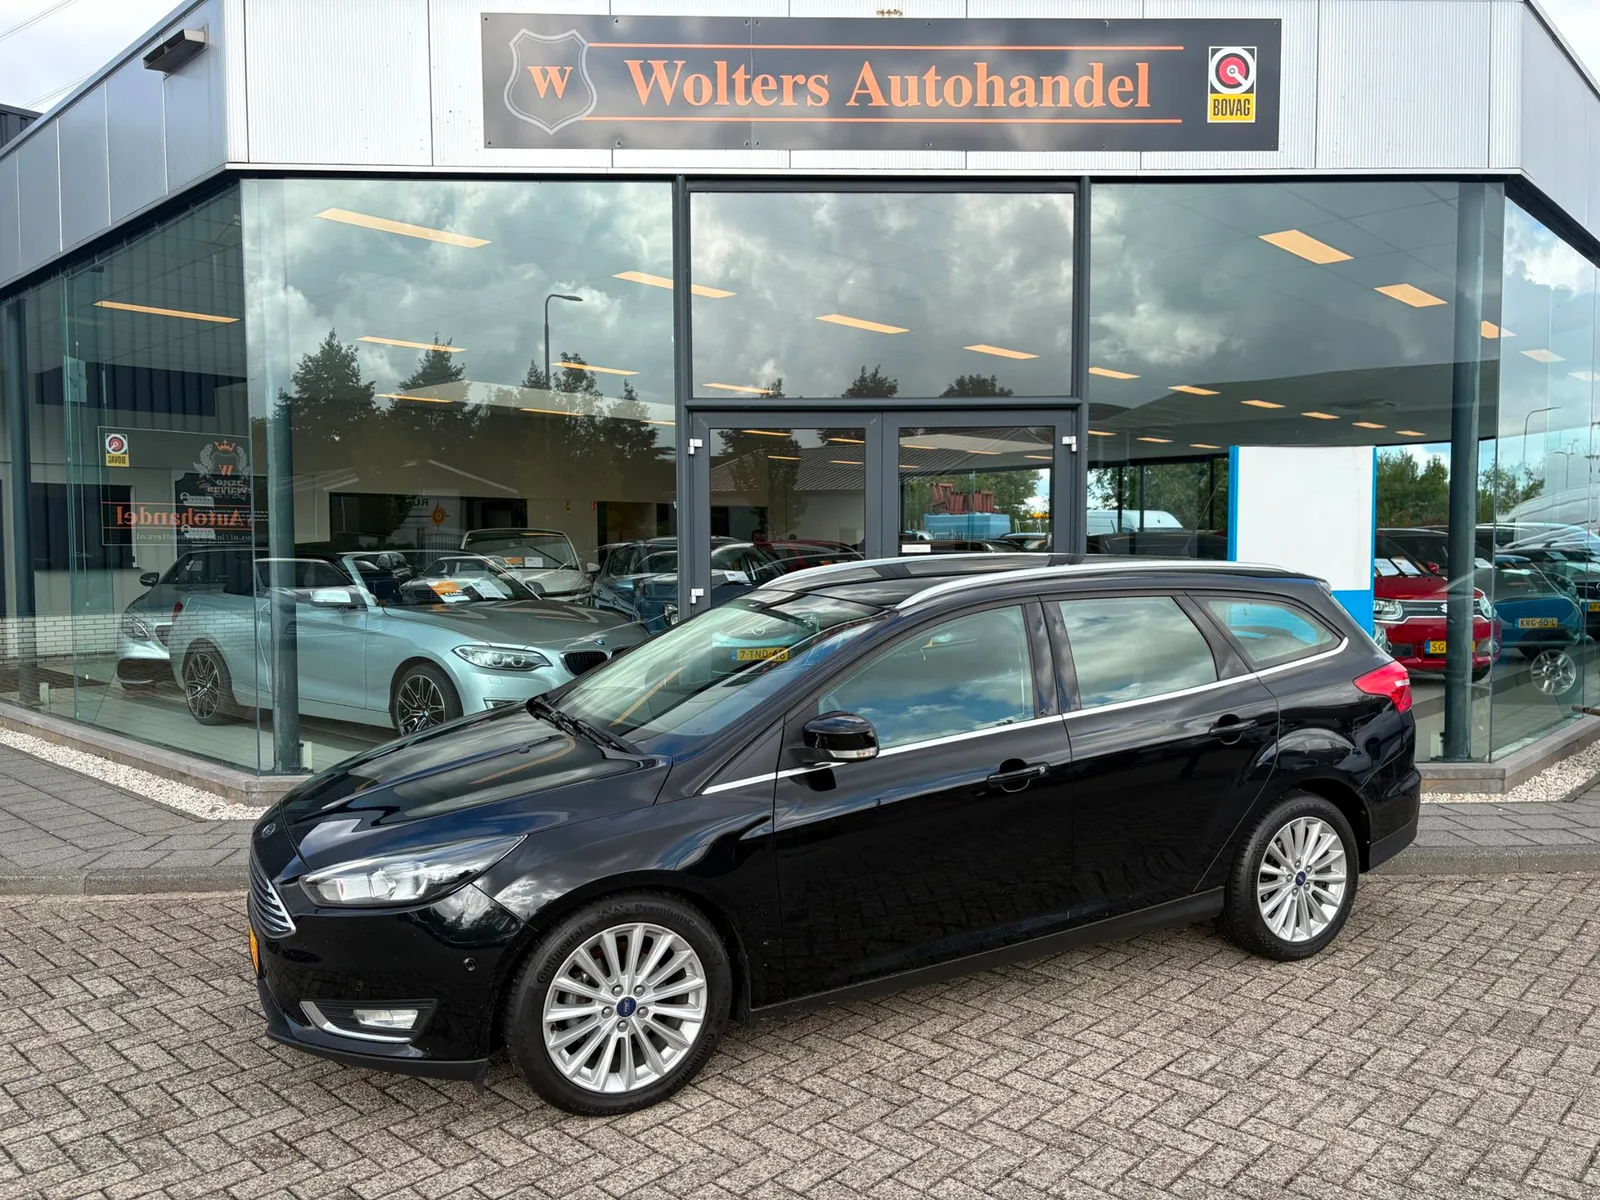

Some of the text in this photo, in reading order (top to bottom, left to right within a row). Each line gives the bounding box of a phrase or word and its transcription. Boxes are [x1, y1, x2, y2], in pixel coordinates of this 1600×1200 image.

[527, 65, 574, 99] W
[623, 59, 1151, 109] Wolters Autohandel
[1212, 98, 1251, 117] BOVAG
